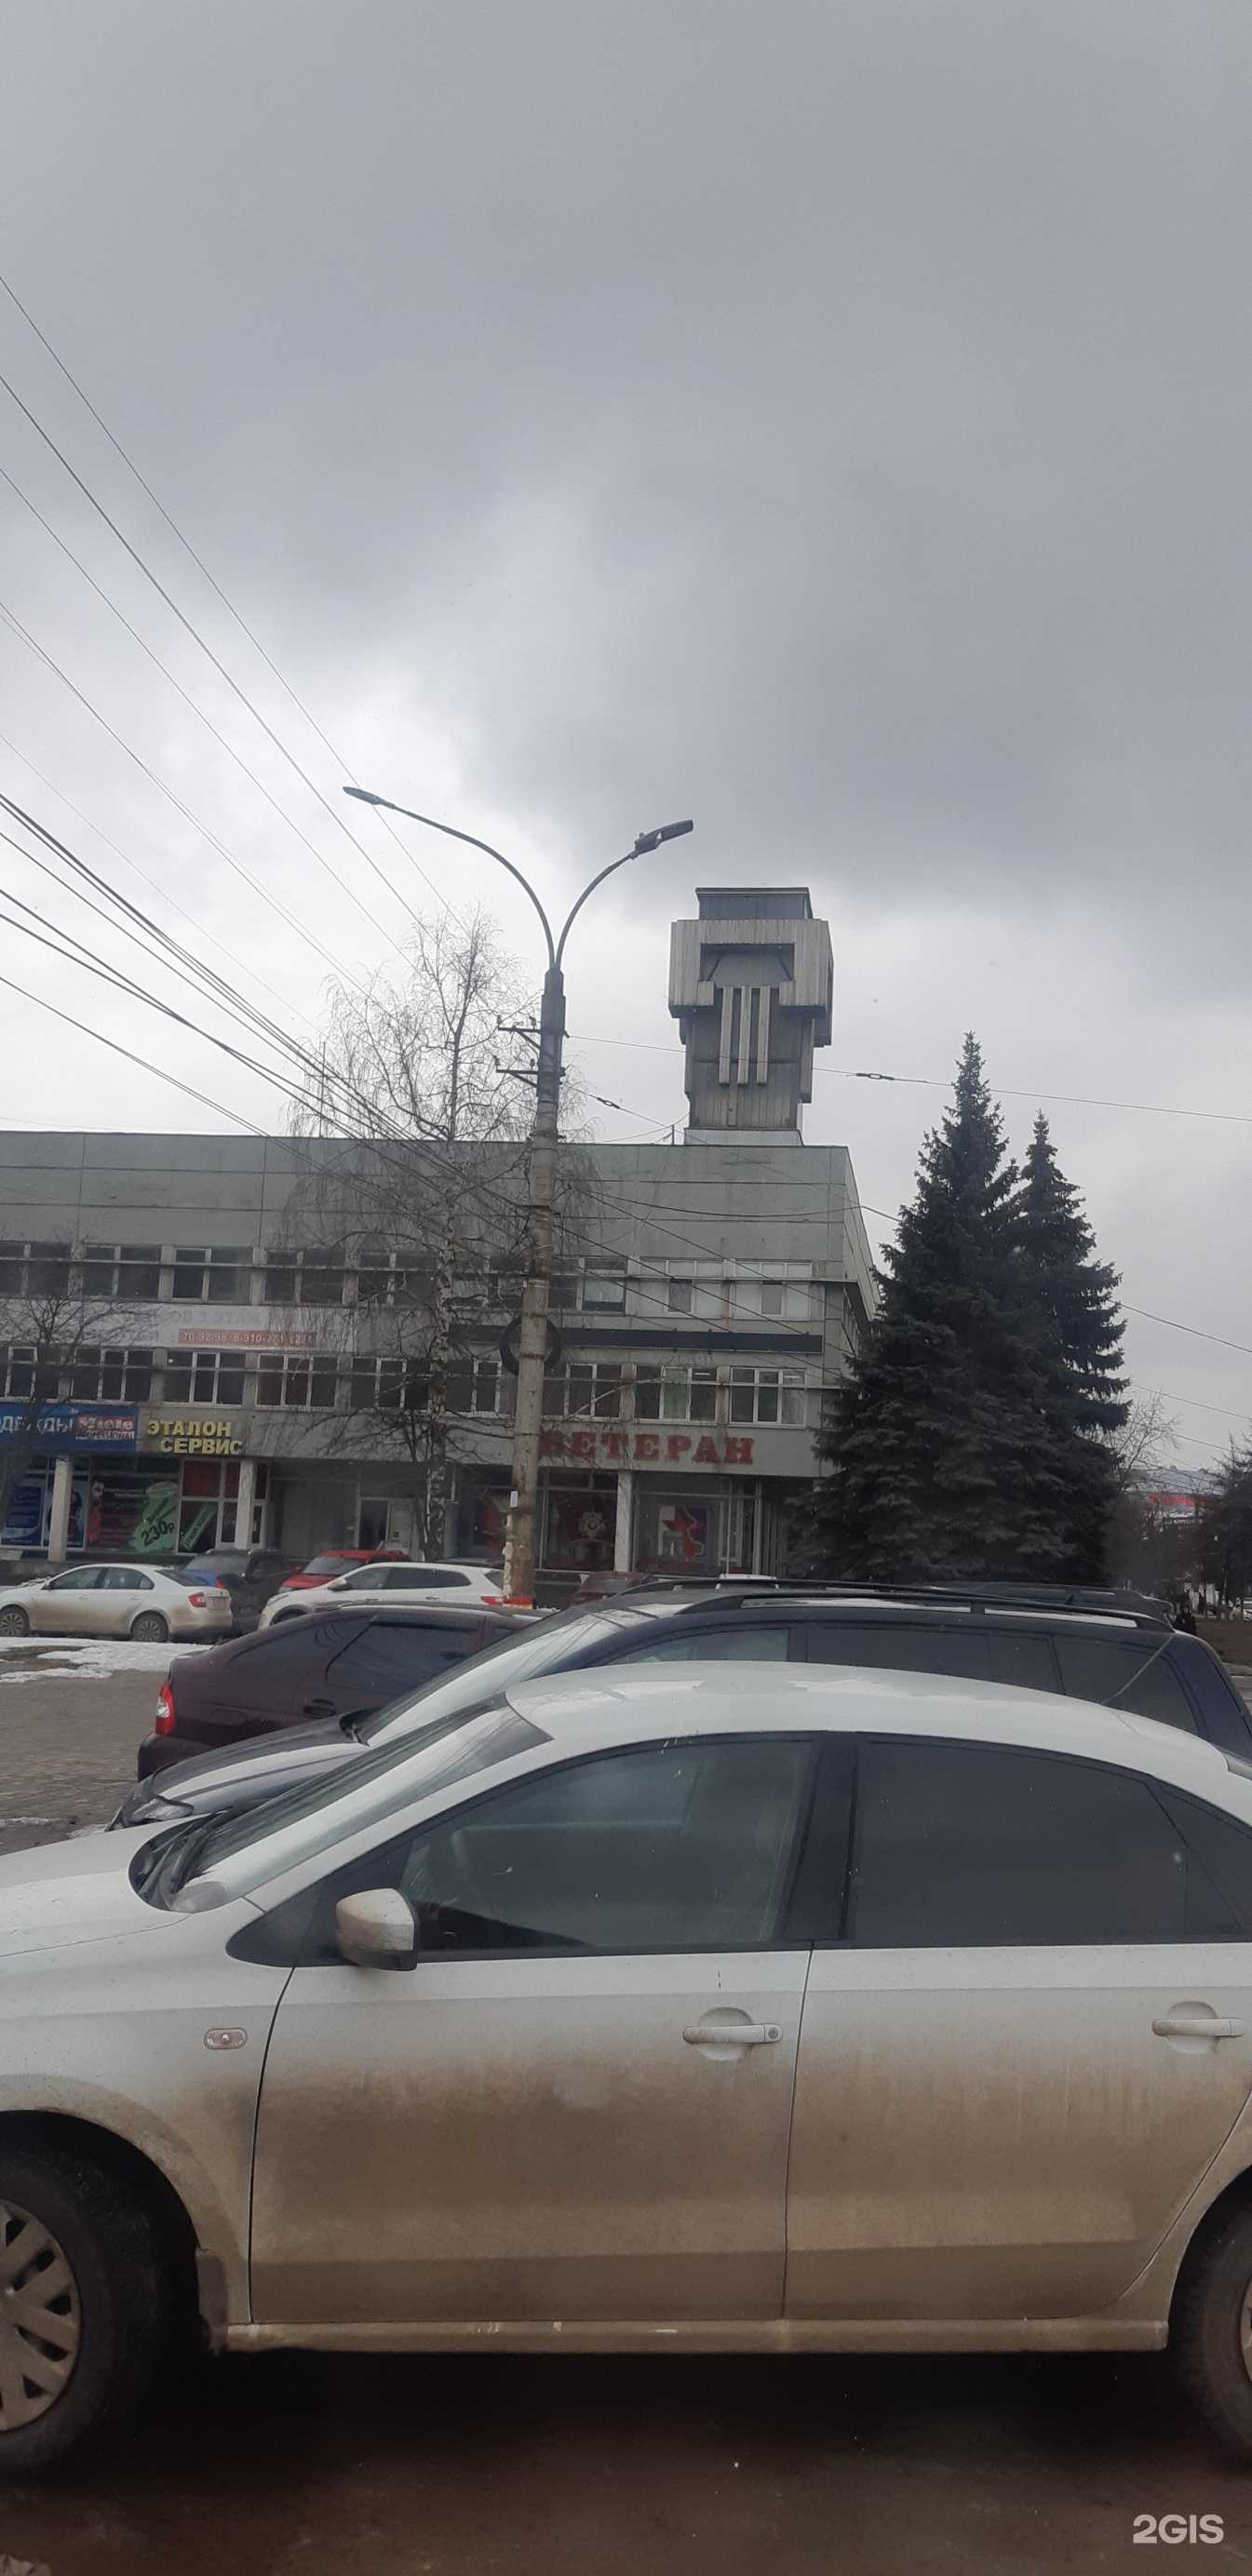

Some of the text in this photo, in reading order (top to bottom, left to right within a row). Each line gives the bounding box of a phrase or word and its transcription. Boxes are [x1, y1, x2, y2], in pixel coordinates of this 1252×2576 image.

[0, 1415, 74, 1434] ДЕДЫ
[148, 1420, 231, 1437] ЭТАЛОН
[160, 1437, 242, 1455] СЕРВИС
[537, 1430, 755, 1465] ВЕТЕРАН
